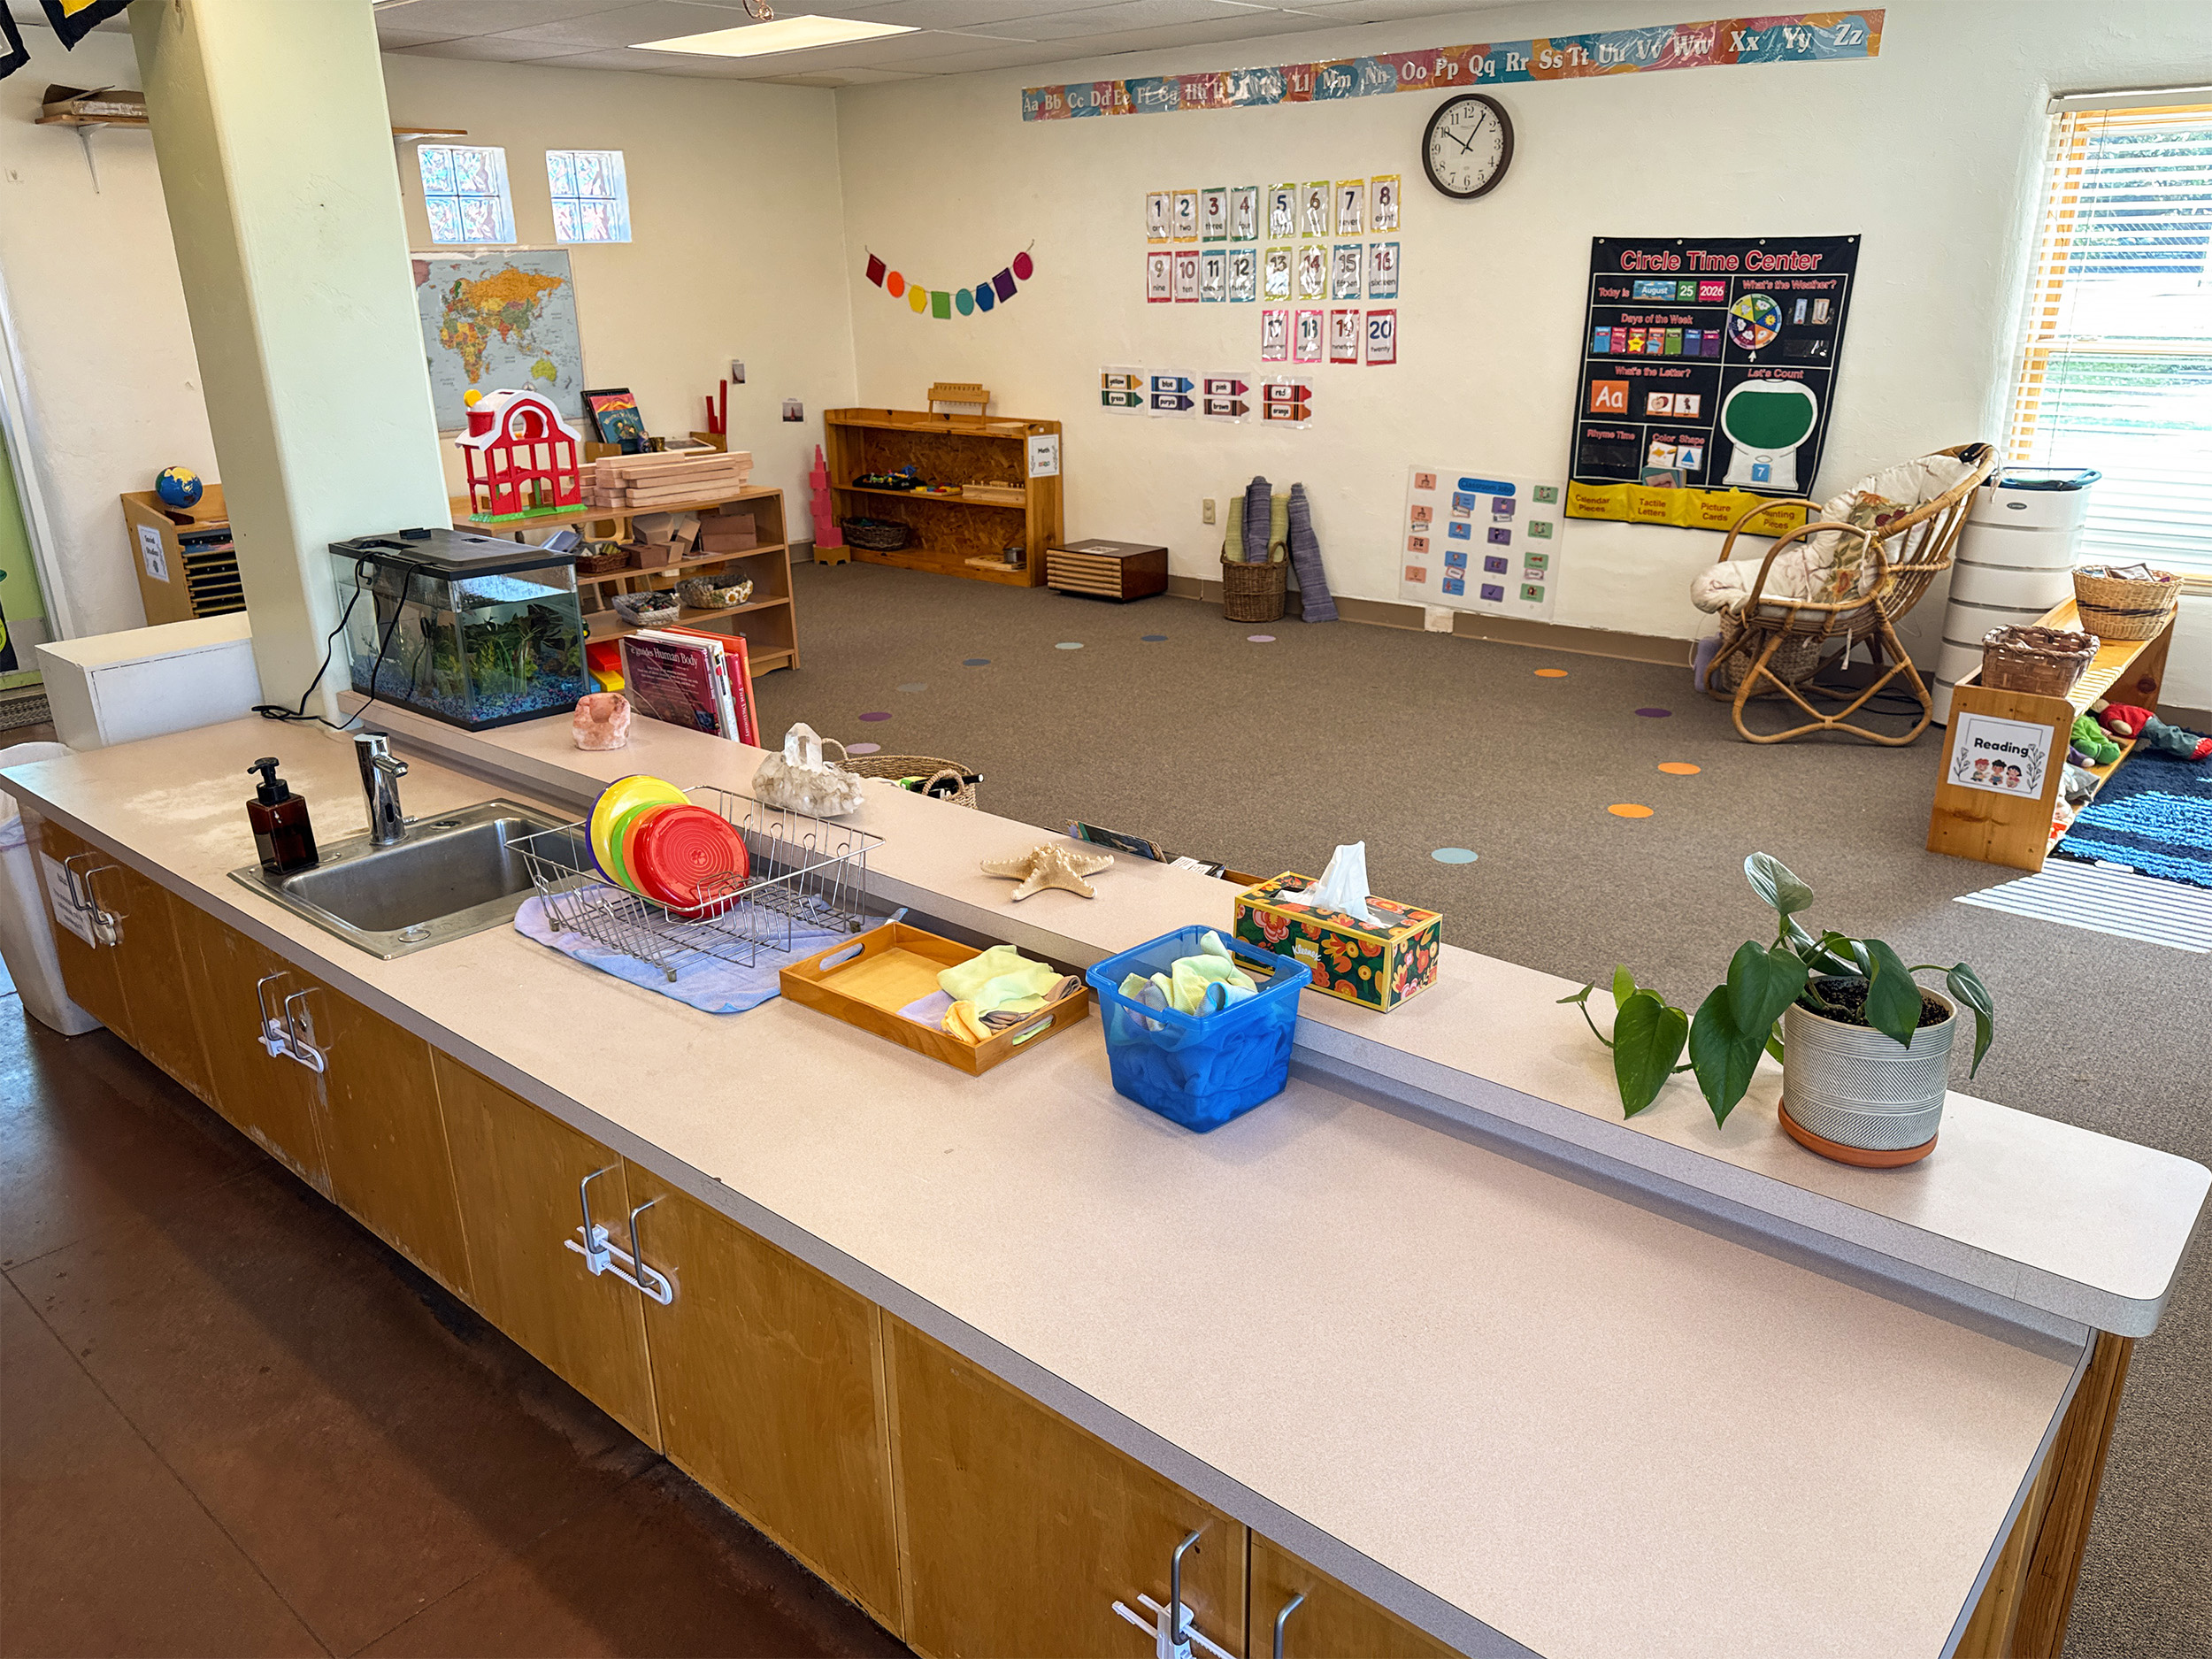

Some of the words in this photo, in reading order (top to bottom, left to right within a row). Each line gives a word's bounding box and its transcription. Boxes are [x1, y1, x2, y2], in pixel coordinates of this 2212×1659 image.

[1024, 96, 1039, 112] Aa
[1045, 95, 1061, 111] Bb
[1067, 93, 1084, 108] Cc
[1090, 89, 1111, 107] Dd
[1113, 89, 1131, 105] Ee
[1294, 73, 1310, 92] Ll
[1323, 70, 1351, 89] Mm
[1402, 61, 1427, 81] Oo
[1434, 58, 1459, 80] Pp
[1469, 55, 1495, 77] Qq
[1506, 52, 1529, 72] Rr
[1539, 49, 1563, 70] Ss
[1570, 46, 1589, 66] Tt
[1598, 43, 1625, 65] Uu
[1636, 38, 1663, 60] Vv
[1674, 35, 1713, 57] Ww
[1729, 30, 1761, 52] Xx
[1785, 27, 1813, 54] Yy
[1833, 23, 1863, 46] Zz
[1463, 106, 1475, 119] 12
[1450, 113, 1460, 125] 11
[1440, 127, 1450, 138] 10
[1489, 120, 1497, 133] 2
[1434, 143, 1441, 155] 9
[1494, 138, 1502, 150] 3
[1439, 160, 1446, 172] 8
[1487, 156, 1494, 168] 4
[1450, 172, 1455, 184] 7
[1463, 175, 1471, 187] 6
[1478, 169, 1485, 181] 5
[1310, 191, 1320, 210] 6
[1345, 191, 1355, 211] 7
[1379, 186, 1390, 206] 8
[1155, 200, 1160, 217] 1
[1180, 199, 1189, 217] 2
[1209, 197, 1218, 215] 3
[1240, 196, 1249, 214] 4
[1277, 195, 1286, 212] 5
[1270, 256, 1286, 273] 13
[1304, 255, 1320, 273] 14
[1339, 254, 1356, 273] 15
[1375, 252, 1393, 271] 16
[1620, 250, 1681, 270] Circle
[1686, 250, 1740, 271] Time
[1745, 250, 1823, 271] Center
[1155, 260, 1163, 278] 9
[1179, 261, 1195, 279] 10
[1208, 260, 1218, 277] 11
[1233, 258, 1249, 277] 12
[1641, 286, 1669, 296] August
[1679, 285, 1694, 296] 25
[1700, 285, 1724, 296] 2026
[1742, 280, 1773, 289] What's
[1774, 280, 1791, 290] the
[1791, 280, 1837, 290] Weather?
[1598, 287, 1620, 299] Today
[1621, 313, 1643, 325] Days
[1645, 313, 1654, 324] of
[1655, 314, 1668, 324] the
[1670, 314, 1694, 325] Week
[1370, 320, 1392, 340] 20
[1615, 365, 1642, 376] What's
[1643, 366, 1657, 376] the
[1660, 367, 1692, 378] Letter?
[1747, 368, 1771, 379] Let's
[1773, 369, 1804, 380] Count
[1595, 386, 1624, 408] Aa
[1587, 429, 1615, 440] Rhyme
[1616, 431, 1635, 441] Time
[1652, 433, 1676, 442] Color
[1678, 434, 1705, 445] Shape
[1757, 468, 1765, 479] 7
[1575, 495, 1610, 504] Calendar
[1640, 498, 1666, 508] Tactile
[1638, 508, 1666, 517] Letters
[1701, 503, 1731, 511] Picture
[1702, 512, 1728, 521] Cards
[1763, 518, 1788, 529] Pieces
[653, 648, 680, 663] Human
[680, 653, 698, 670] Body
[1974, 738, 2030, 758] Reading
[1292, 944, 1322, 962] Kleenex
